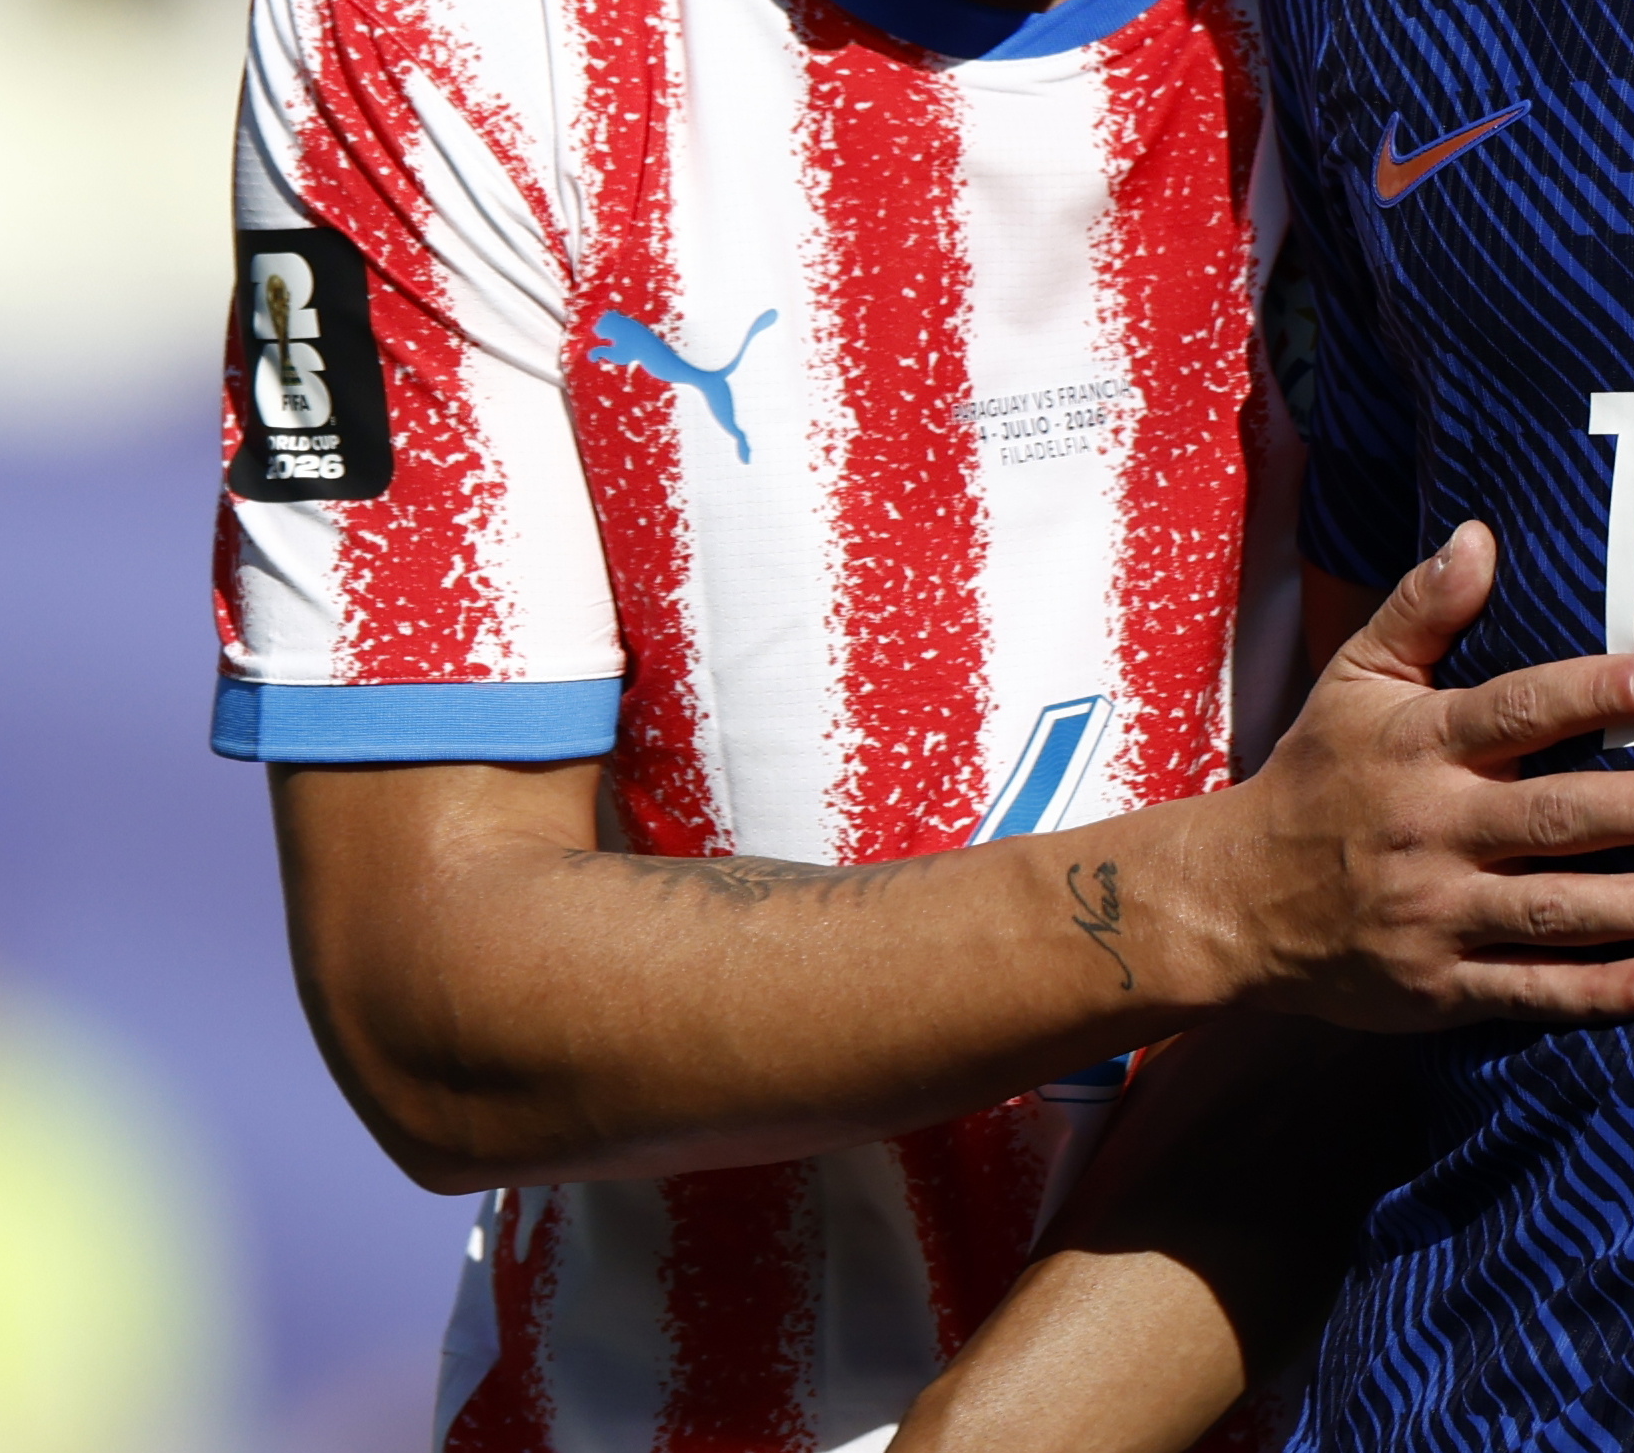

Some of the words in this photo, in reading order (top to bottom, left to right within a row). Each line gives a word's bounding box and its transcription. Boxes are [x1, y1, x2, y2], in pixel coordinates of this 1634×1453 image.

[281, 394, 311, 412] FIFA
[951, 394, 1029, 423] PARAGUAY
[1031, 390, 1054, 410] VS
[1057, 378, 1131, 406] FRANCIA
[1001, 415, 1050, 441] JULIO
[1066, 407, 1109, 430] 2026
[268, 435, 312, 451] ORLD
[312, 434, 342, 451] CUP
[1001, 436, 1092, 466] FILADELFIA
